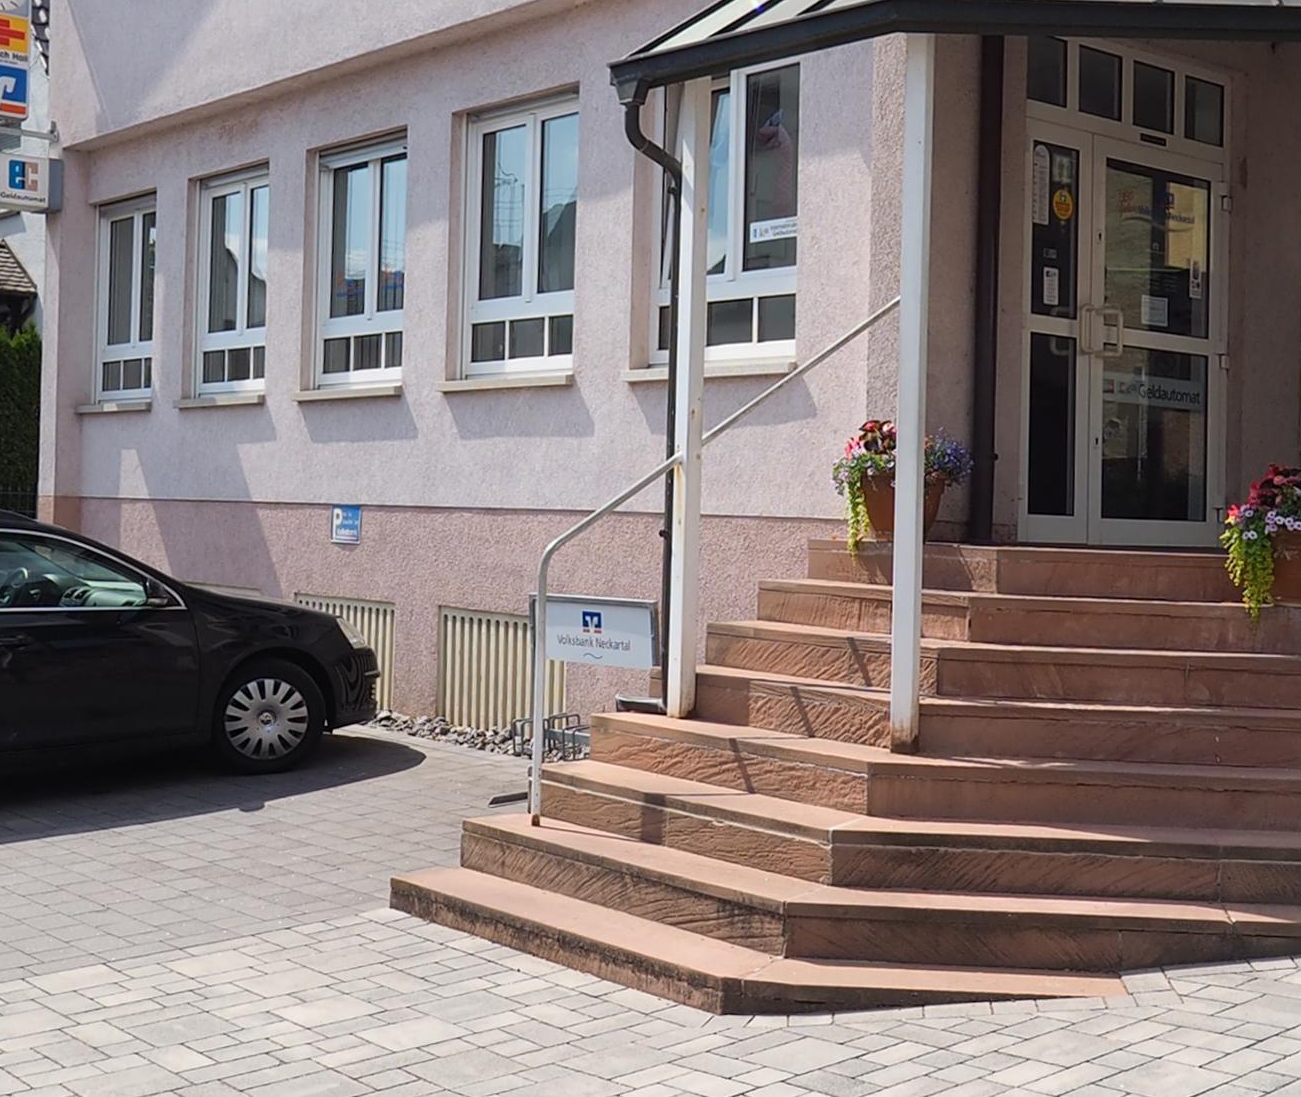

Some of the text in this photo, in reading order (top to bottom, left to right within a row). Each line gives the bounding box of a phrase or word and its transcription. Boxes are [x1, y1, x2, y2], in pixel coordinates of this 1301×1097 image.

[0, 191, 46, 203] Geldautomat
[1139, 383, 1200, 405] Geldautomat
[557, 634, 631, 651] Volksbank Neckartal
